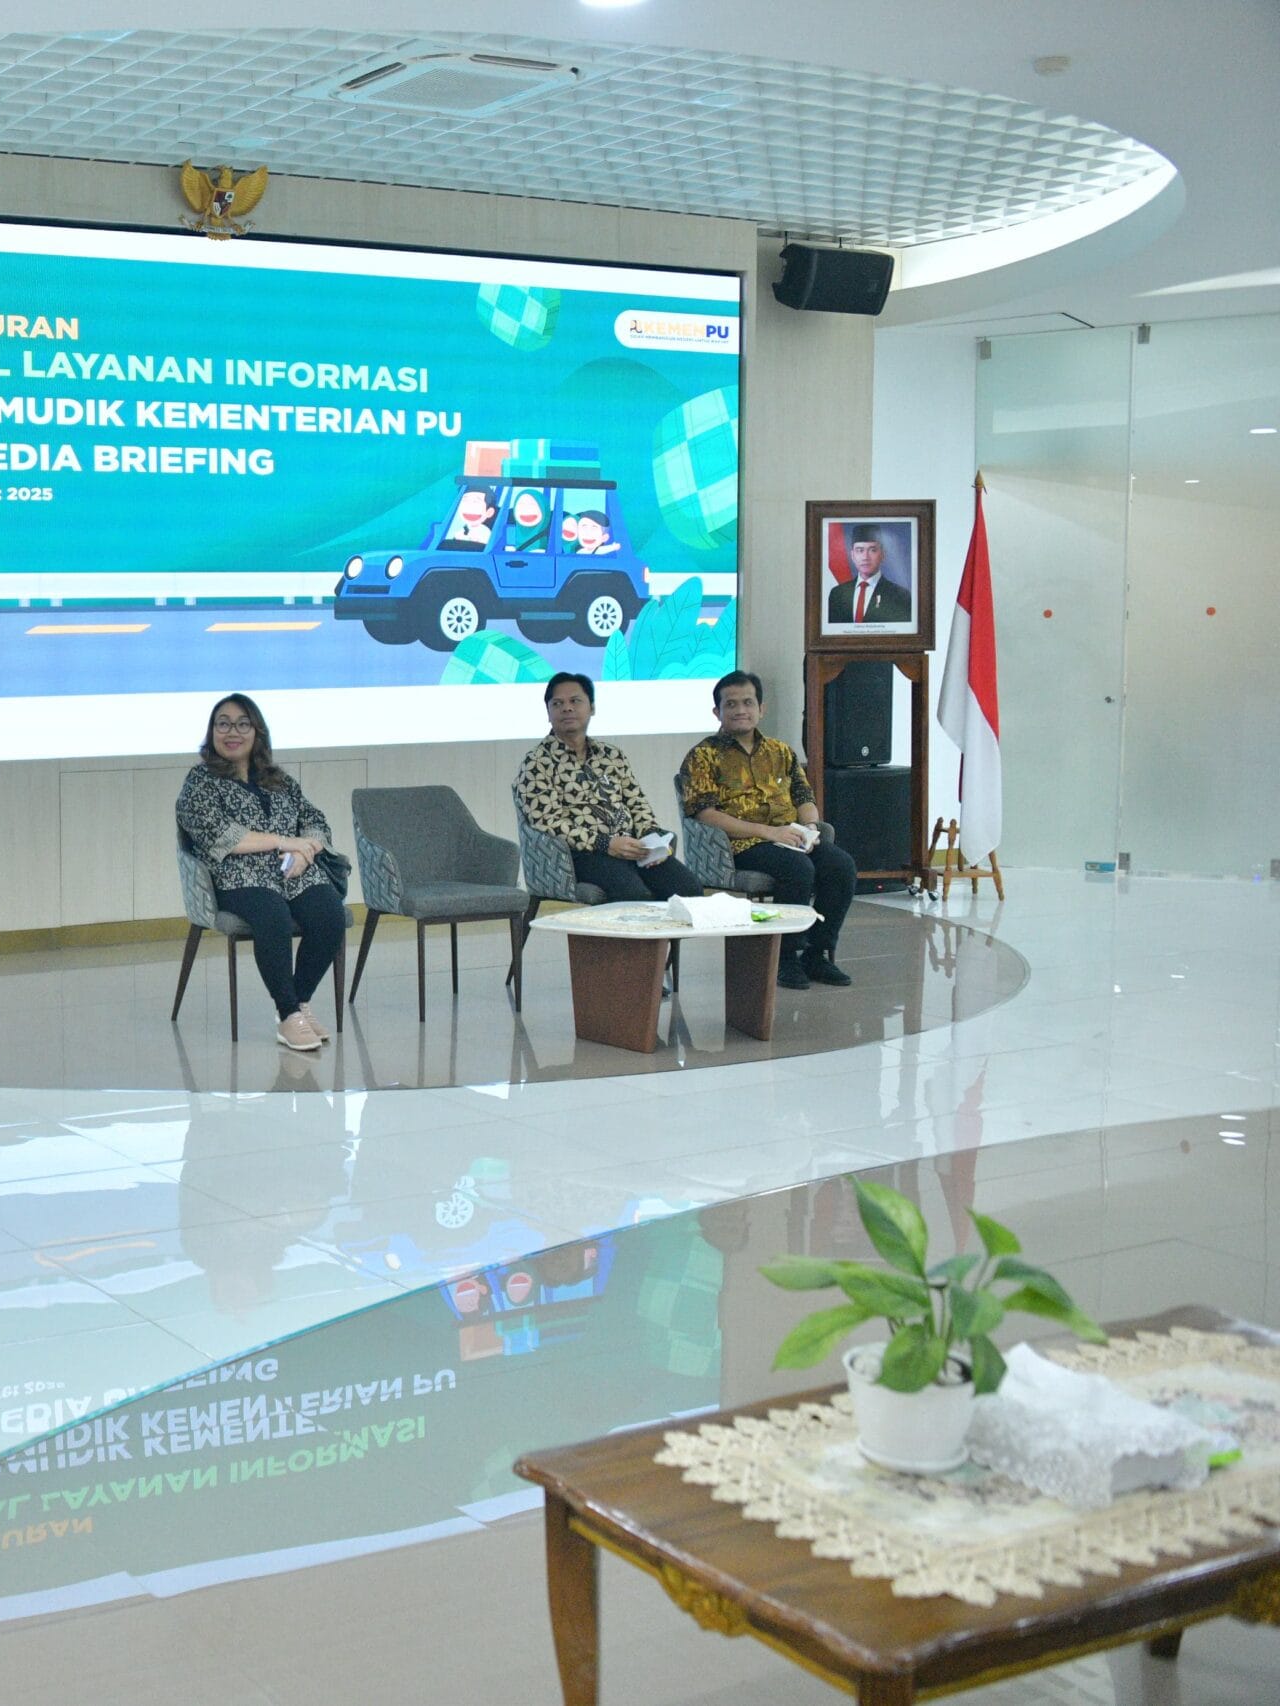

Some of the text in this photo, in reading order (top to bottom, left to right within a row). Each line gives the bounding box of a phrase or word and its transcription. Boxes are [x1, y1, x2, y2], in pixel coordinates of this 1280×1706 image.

[23, 350, 212, 384] LAYANAN
[225, 358, 429, 393] INFORMASI
[136, 400, 406, 435] KEMENTERIAN
[416, 410, 462, 437] PU
[94, 445, 274, 476] BRIEFING
[7, 487, 53, 501] 2025
